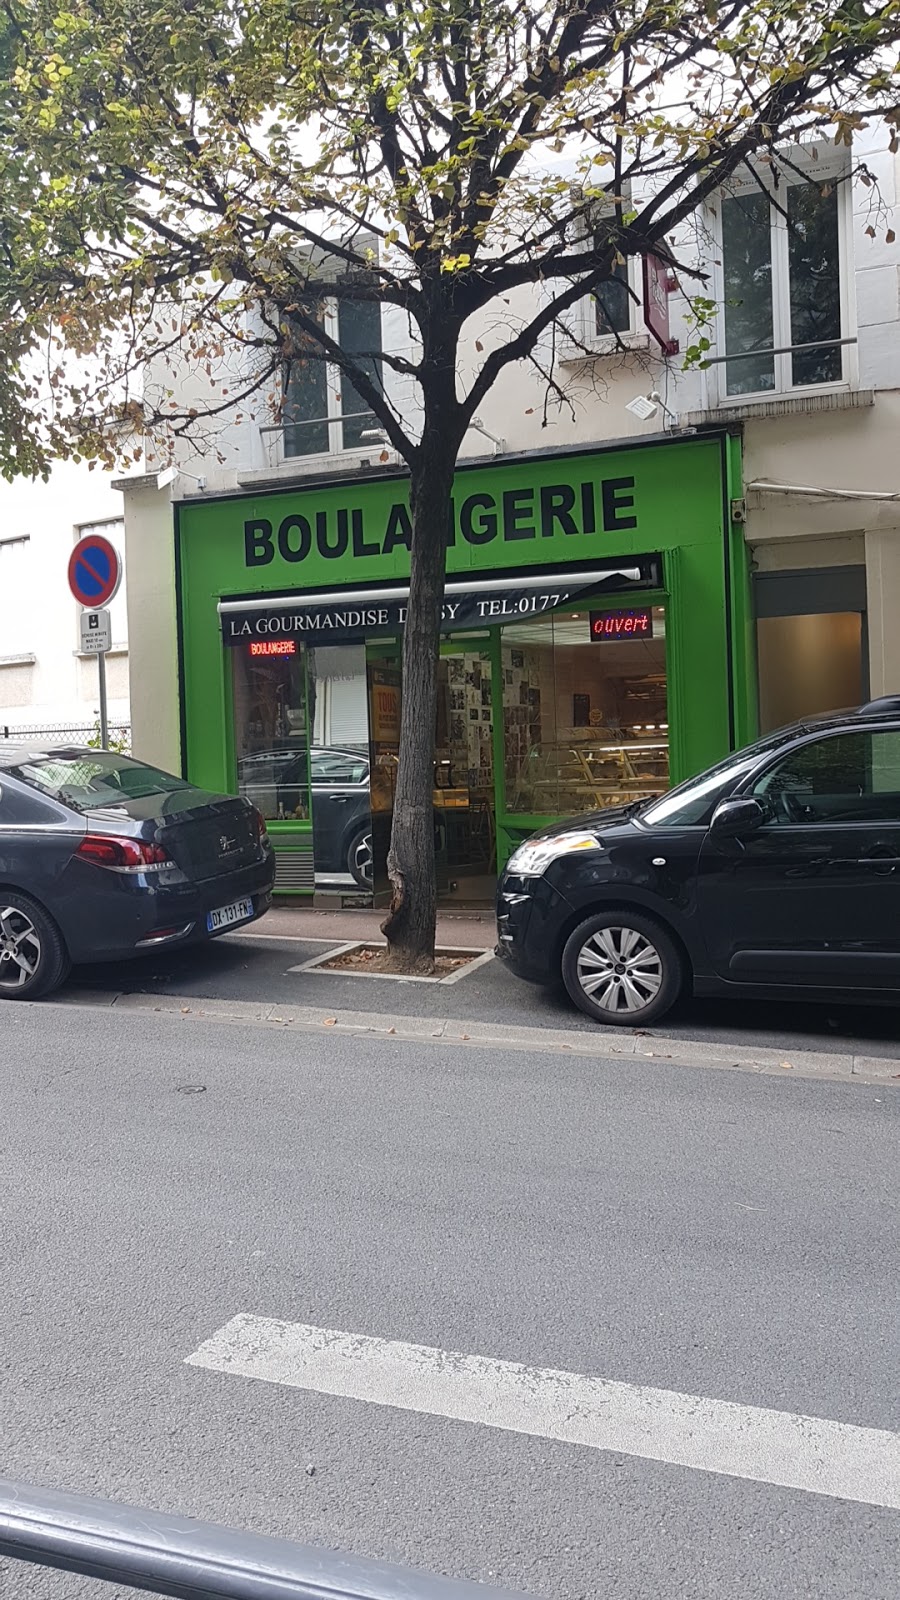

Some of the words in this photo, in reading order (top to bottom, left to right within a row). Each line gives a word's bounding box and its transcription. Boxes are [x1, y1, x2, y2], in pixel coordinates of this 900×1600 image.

[230, 620, 252, 636] LA
[256, 609, 389, 633] GOURMANDISE
[477, 593, 570, 617] TEL:0177
[594, 614, 649, 634] ouvert
[251, 640, 296, 655] BOULANGERIE
